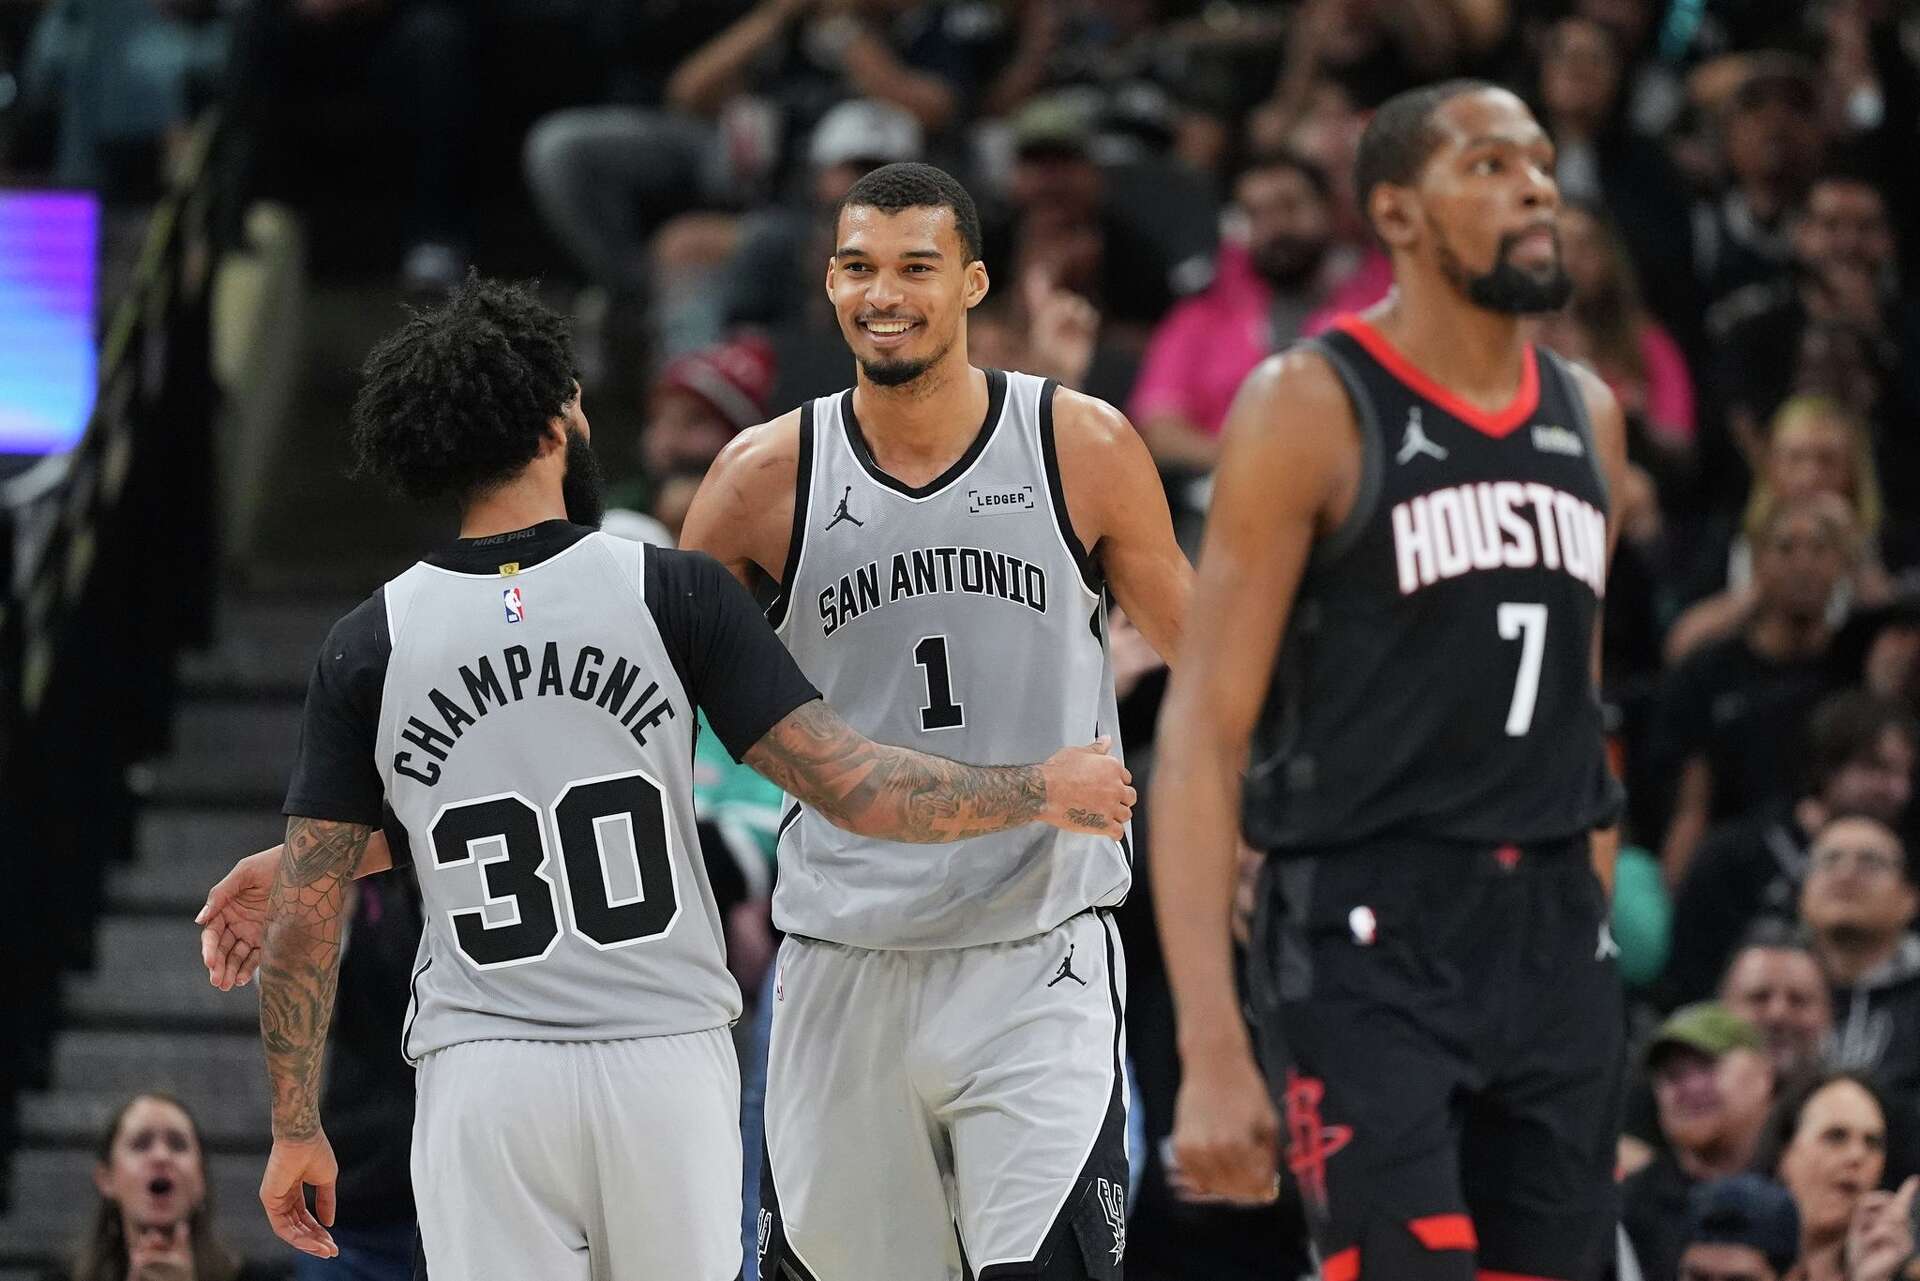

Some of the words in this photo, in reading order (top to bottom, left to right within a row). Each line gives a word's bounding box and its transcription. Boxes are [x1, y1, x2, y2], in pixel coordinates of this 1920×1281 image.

[473, 535, 506, 547] NIKE
[507, 529, 536, 542] PRO
[976, 493, 1026, 507] LEDGER
[818, 561, 882, 639] SAN
[889, 546, 1047, 616] ANTONIO
[393, 641, 676, 787] CHAMPAGNIE
[912, 634, 966, 732] 1
[1496, 602, 1549, 736] 7
[425, 769, 684, 971] 30
